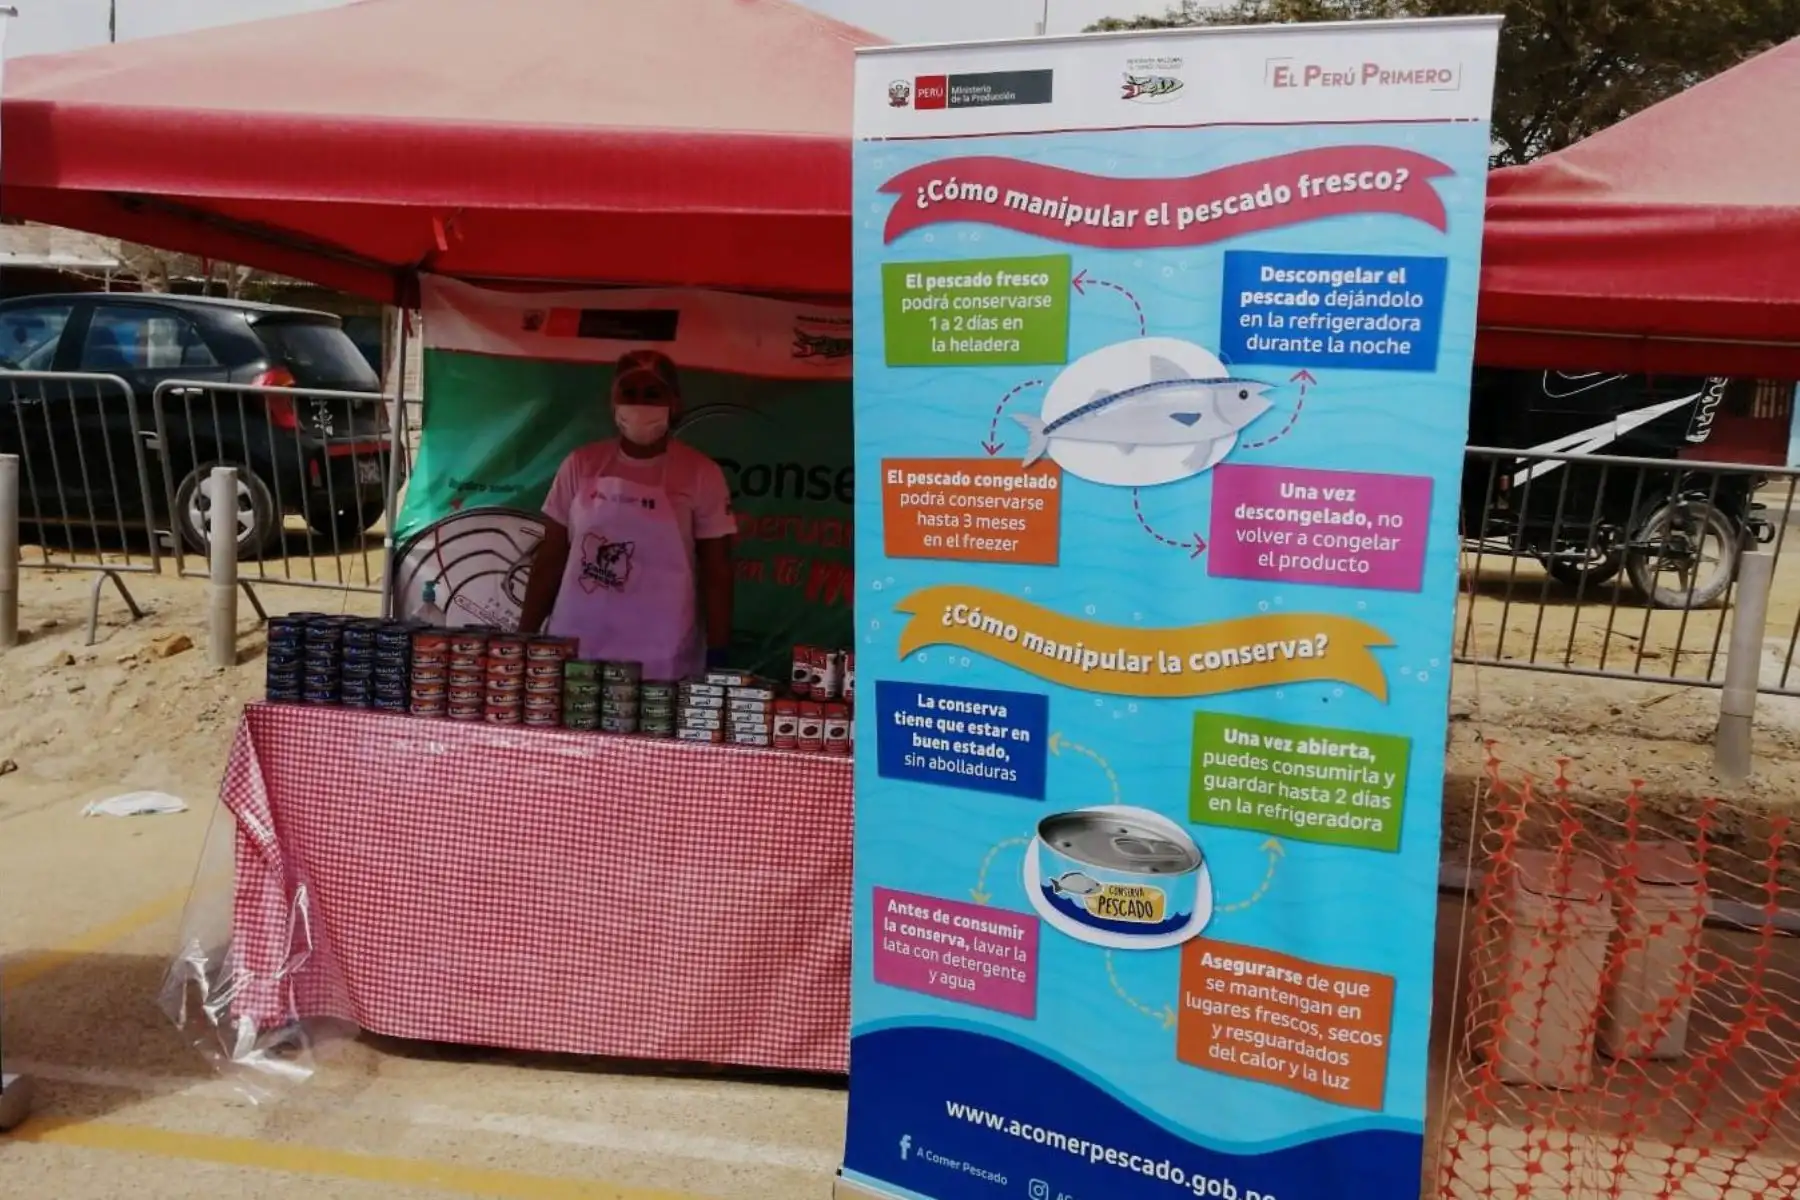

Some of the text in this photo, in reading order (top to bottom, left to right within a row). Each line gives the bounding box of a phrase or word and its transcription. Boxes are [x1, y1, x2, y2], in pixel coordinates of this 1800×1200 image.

[1361, 62, 1453, 86] PRIMERO
[917, 86, 944, 98] PERÚ
[951, 84, 992, 95] Ministerio
[951, 91, 1016, 103] de la Producción
[918, 168, 1408, 232] ¿Cómo manipular el pescado fresco?
[906, 271, 1049, 291] El pescado fresco
[1261, 266, 1406, 286] Descongelar el
[902, 295, 1051, 312] podrá conservarse
[1241, 290, 1423, 309] pescado dejándolo
[930, 315, 1023, 332] 1 a 2 días en
[1240, 312, 1420, 333] en la refrigeradora
[932, 337, 1019, 352] la heladera
[1247, 334, 1410, 354] durante la noche
[888, 470, 1057, 491] El pescado congelado
[1281, 483, 1355, 501] Una vez
[901, 492, 1043, 510] podrá conservarse
[918, 512, 1025, 530] hasta 3 meses
[1235, 504, 1402, 529] descongelado, no
[924, 534, 1018, 551] en el freezer
[1237, 528, 1400, 552] volver a congelar
[1259, 551, 1369, 573] el producto
[942, 604, 1327, 673] ¿Cómo manipular la conserva?
[918, 694, 1007, 717] La conserva
[895, 711, 1029, 741] tiene que estar en
[913, 733, 1009, 761] buen estado,
[1224, 729, 1375, 762] Una vez abierta,
[905, 752, 1016, 781] sin abolladuras
[1203, 753, 1395, 788] puedes consumirla y
[1204, 775, 1391, 809] guardar hasta 2 días
[1209, 798, 1382, 831] en la refrigeradora
[1108, 885, 1144, 896] CONSERVA
[888, 899, 1025, 939] Antes de consumir
[1097, 895, 1154, 919] PESCADO
[885, 917, 1026, 962] la conserva, lavar la
[884, 937, 1027, 983] lata con detergente
[929, 970, 975, 990] y agua
[1201, 953, 1370, 998] Asegurarse de que
[1207, 977, 1361, 1019] se mantengan en
[1187, 992, 1382, 1046] lugares frescos, secos
[1212, 1023, 1350, 1067] y resguardados
[1209, 1043, 1350, 1090] del calor y la luz
[917, 1147, 925, 1158] A
[926, 1150, 961, 1169] Comer
[962, 1162, 1008, 1185] Pescado
